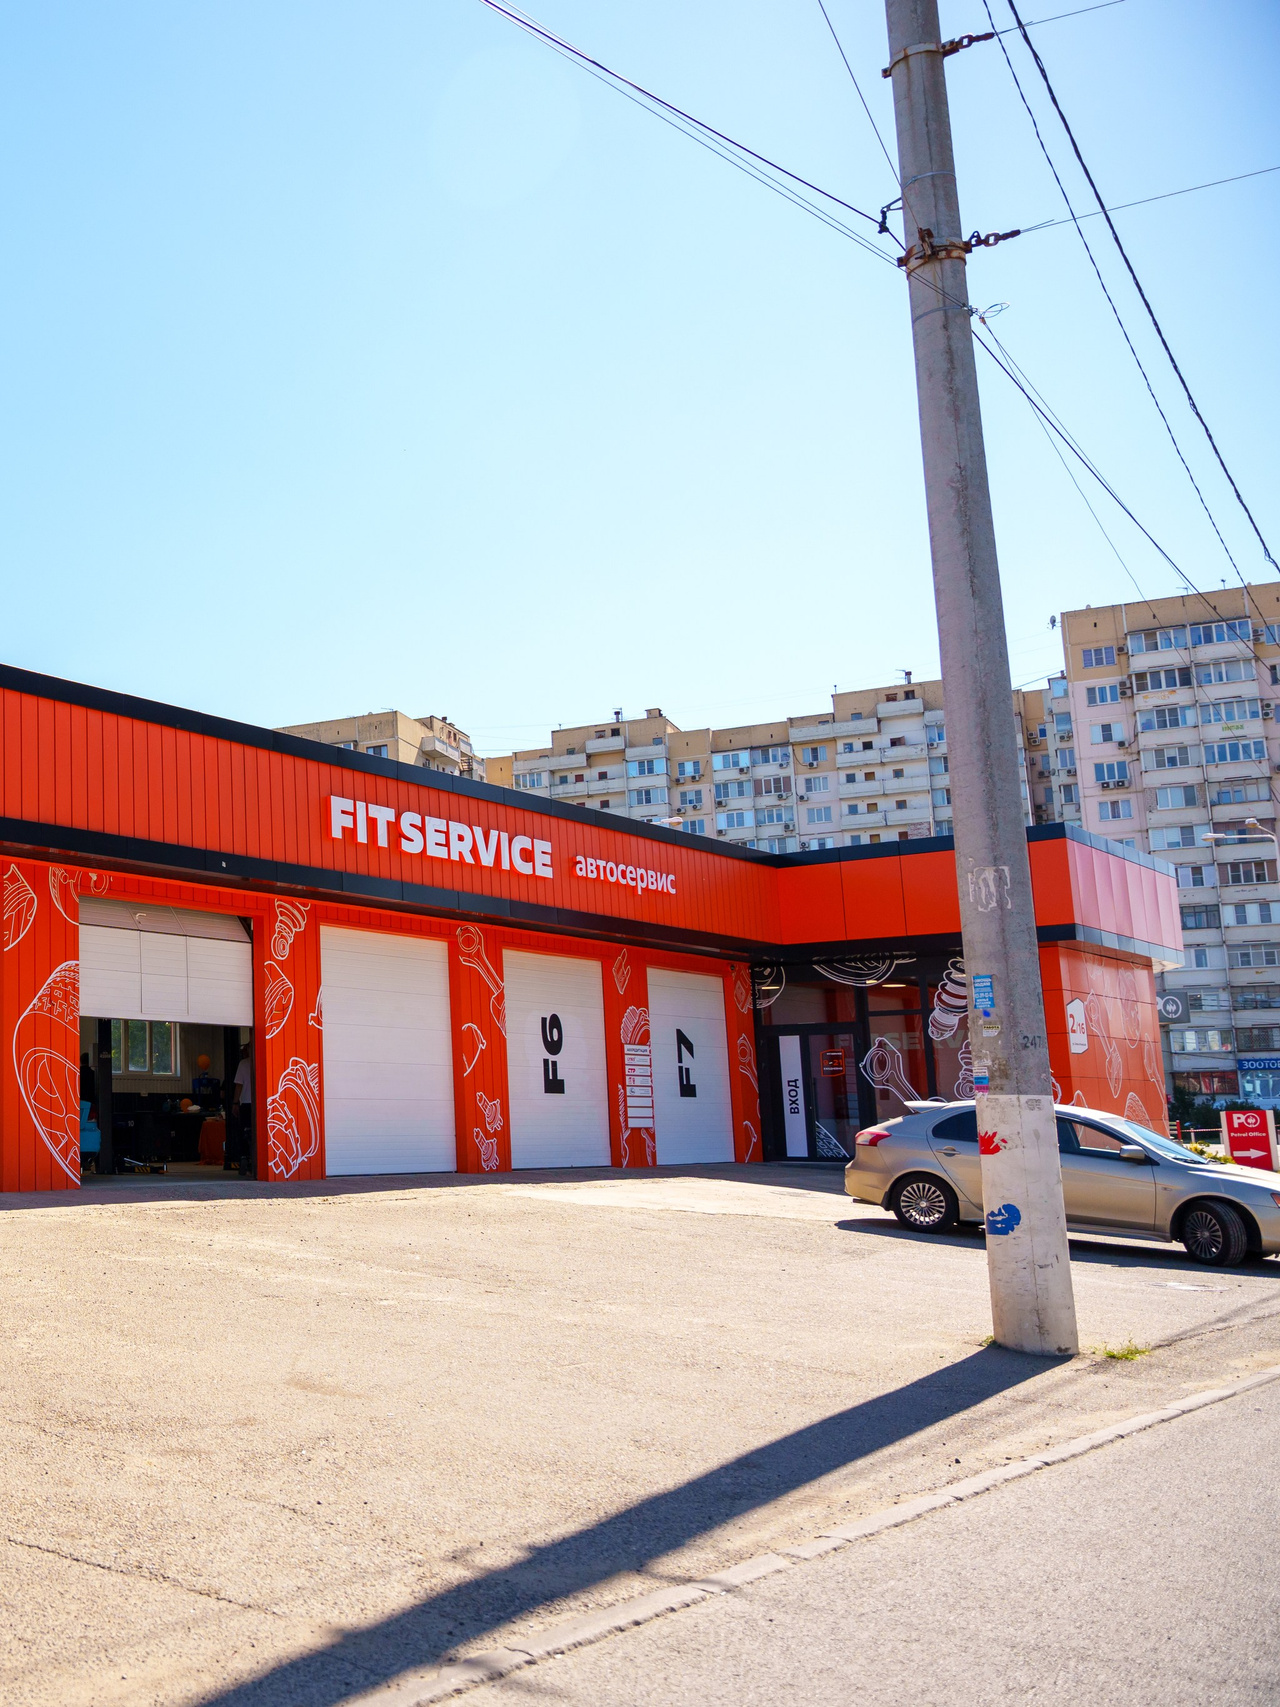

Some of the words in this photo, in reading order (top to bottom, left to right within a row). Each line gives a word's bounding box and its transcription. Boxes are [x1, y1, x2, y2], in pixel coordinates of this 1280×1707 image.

[330, 795, 396, 848] FIT
[399, 811, 554, 880] SERVICE
[575, 855, 676, 895] автосервис
[541, 1013, 565, 1095] F6
[675, 1028, 697, 1098] F7
[1022, 1035, 1041, 1050] 247
[787, 1078, 800, 1114] ВХОД
